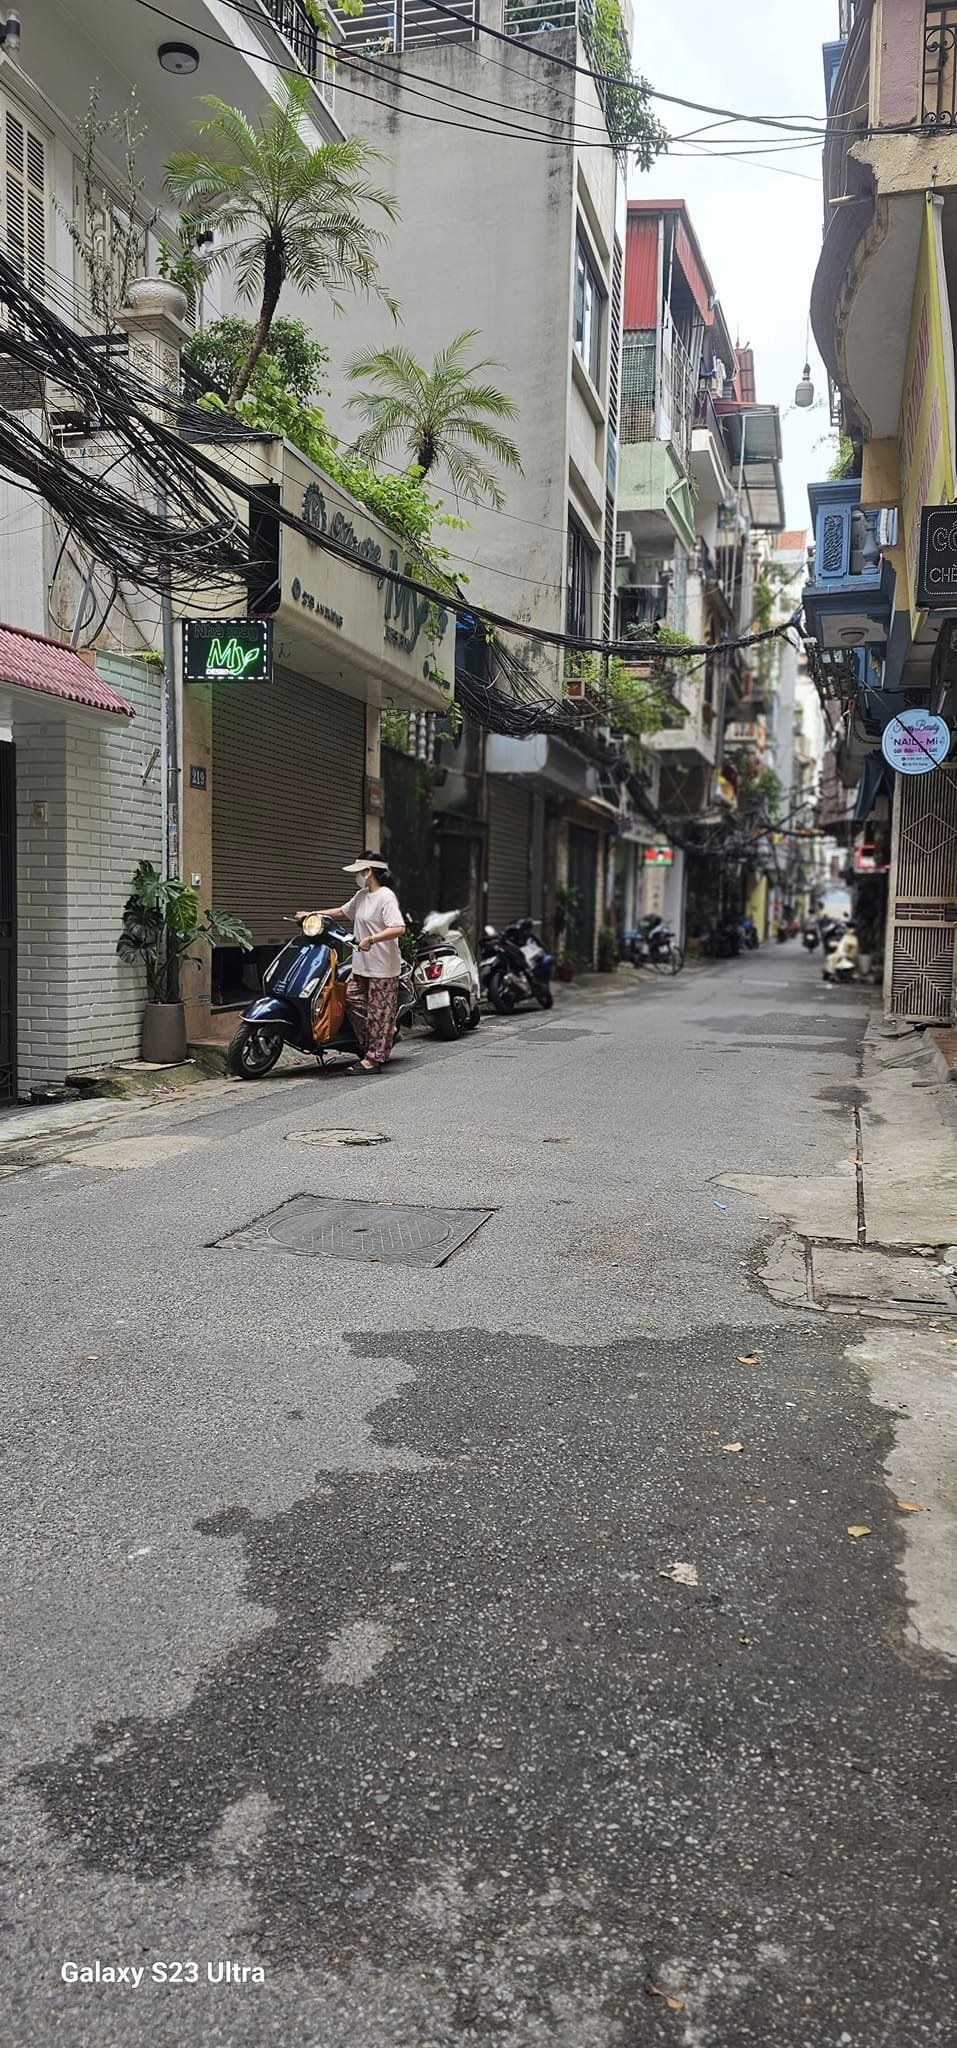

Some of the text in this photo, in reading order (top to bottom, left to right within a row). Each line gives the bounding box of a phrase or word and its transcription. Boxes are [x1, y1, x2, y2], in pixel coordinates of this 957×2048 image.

[206, 638, 259, 676] My
[894, 738, 917, 746] NAIL
[191, 768, 205, 785] 219
